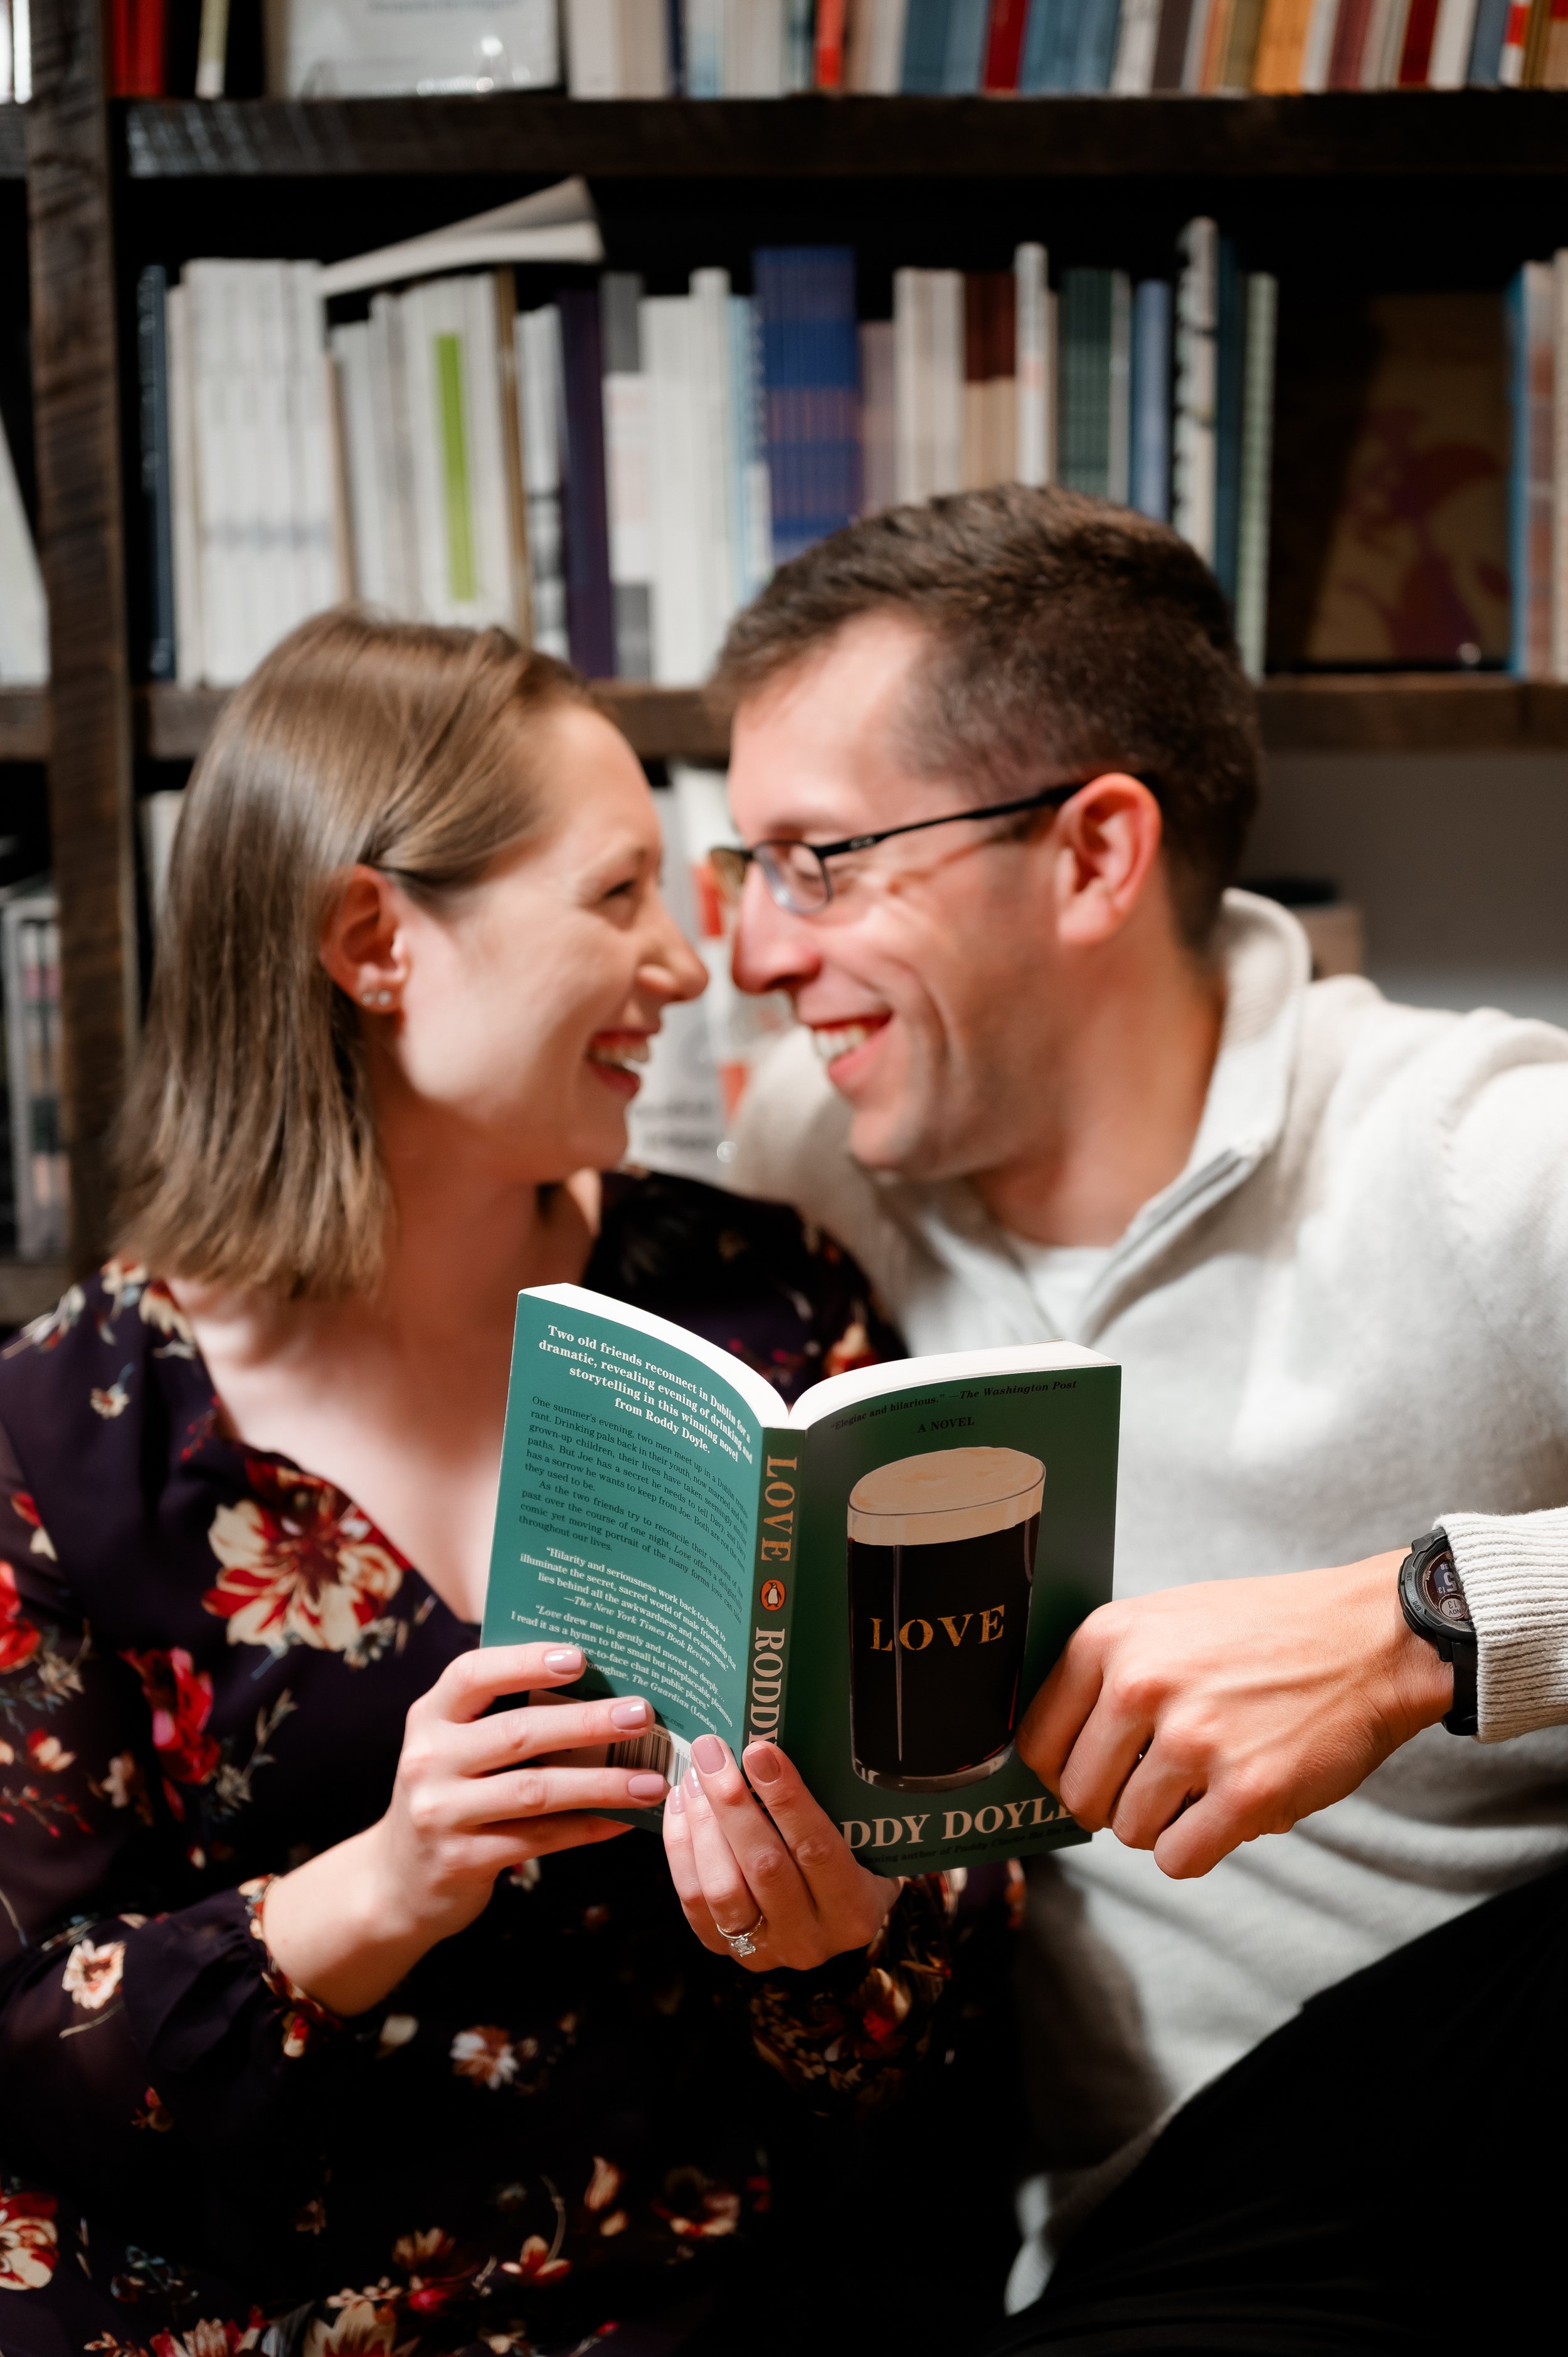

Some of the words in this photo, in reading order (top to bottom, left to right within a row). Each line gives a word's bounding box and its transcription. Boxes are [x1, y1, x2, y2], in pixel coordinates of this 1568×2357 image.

[539, 1339, 597, 1368] dramatic,
[601, 1361, 655, 1390] revealing
[658, 1385, 697, 1413] evening
[699, 1407, 710, 1419] of
[711, 1413, 742, 1451] drinking
[742, 1446, 752, 1464] and
[548, 1325, 574, 1342] Two
[578, 1336, 596, 1349] old
[600, 1343, 642, 1366] friends
[645, 1361, 697, 1394] reconnect
[699, 1387, 707, 1402] in
[710, 1394, 735, 1425] Dublin
[737, 1419, 747, 1439] for
[569, 1368, 641, 1401] storytelling
[643, 1391, 654, 1405] in
[658, 1400, 678, 1417] this
[681, 1412, 718, 1444] winning
[719, 1439, 738, 1462] novel
[869, 1405, 887, 1418] and
[983, 1383, 1049, 1397] Washington
[1052, 1380, 1078, 1390] Post
[531, 1411, 551, 1422] rant.
[554, 1416, 595, 1438] Drinking
[596, 1432, 615, 1443] pals
[617, 1437, 637, 1452] back
[639, 1446, 647, 1456] in
[649, 1451, 668, 1466] their
[669, 1462, 691, 1481] youth,
[693, 1476, 707, 1489] now
[708, 1486, 730, 1510] married
[532, 1396, 550, 1408] One
[599, 1419, 634, 1439] evening,
[637, 1433, 653, 1445] two
[655, 1441, 672, 1454] men
[674, 1451, 692, 1466] meet
[694, 1462, 702, 1473] up
[718, 1477, 734, 1501] Dublin
[615, 1397, 642, 1417] from
[645, 1408, 679, 1435] Roddy
[681, 1427, 710, 1454] Doyle.
[918, 1423, 927, 1433] A
[931, 1415, 975, 1431] NOVEL
[525, 1463, 544, 1476] they
[548, 1470, 568, 1482] used
[526, 1449, 543, 1460] has
[551, 1459, 584, 1473] sorrow
[599, 1474, 625, 1487] wants
[637, 1486, 657, 1503] keep
[659, 1496, 677, 1512] from
[678, 1506, 692, 1521] Joe.
[694, 1515, 709, 1533] Both
[527, 1437, 554, 1451] paths.
[559, 1445, 575, 1457] But
[578, 1451, 593, 1463] Joe
[596, 1457, 612, 1470] has
[623, 1469, 649, 1484] secret
[664, 1486, 686, 1503] needs
[710, 1513, 725, 1535] Davy,
[529, 1424, 572, 1444] grown-up
[576, 1438, 615, 1458] children,
[618, 1452, 639, 1466] their
[642, 1460, 660, 1476] lives
[663, 1471, 681, 1486] have
[684, 1482, 702, 1501] taken
[704, 1498, 732, 1527] seemingly
[760, 1455, 798, 1562] LOVE
[519, 1516, 569, 1537] throughout
[572, 1533, 588, 1542] our
[590, 1536, 612, 1551] lives.
[520, 1504, 548, 1516] comic
[551, 1513, 565, 1522] yet
[569, 1518, 602, 1535] moving
[605, 1530, 638, 1548] portrait
[669, 1556, 689, 1573] many
[691, 1569, 709, 1588] forms
[522, 1491, 541, 1501] past
[544, 1498, 565, 1508] over
[568, 1503, 583, 1514] the
[586, 1510, 615, 1525] course
[630, 1526, 645, 1537] one
[649, 1534, 670, 1550] night,
[674, 1545, 691, 1561] Love
[693, 1558, 711, 1576] offers
[555, 1486, 569, 1496] the
[573, 1491, 590, 1503] two
[593, 1497, 624, 1514] friends
[655, 1523, 689, 1546] reconcile
[692, 1543, 707, 1558] their
[709, 1556, 731, 1581] versions
[520, 1553, 568, 1574] illuminate
[569, 1568, 585, 1579] the
[586, 1575, 617, 1591] secret,
[618, 1586, 648, 1602] sacred
[649, 1598, 672, 1614] world
[674, 1611, 682, 1619] of
[682, 1615, 699, 1631] male
[701, 1627, 728, 1659] friendship
[538, 1572, 555, 1584] lies
[556, 1577, 589, 1594] behind
[590, 1589, 603, 1599] all
[605, 1593, 619, 1604] the
[621, 1600, 677, 1630] awkwardness
[678, 1627, 692, 1640] and
[587, 1562, 605, 1572] and
[606, 1568, 657, 1593] seriousness
[659, 1589, 678, 1604] work
[679, 1598, 719, 1636] back-to-back
[593, 1602, 615, 1615] New
[617, 1610, 637, 1624] York
[639, 1619, 665, 1637] Times
[666, 1632, 686, 1648] Book
[686, 1644, 711, 1667] Review
[870, 1604, 1005, 1651] LOVE
[1448, 1600, 1456, 1609] 13
[517, 1615, 538, 1627] read
[569, 1627, 596, 1643] hymn
[610, 1641, 625, 1652] the
[627, 1647, 651, 1662] small
[652, 1656, 665, 1669] but
[667, 1663, 711, 1700] irreplaceable
[563, 1613, 588, 1625] drew
[590, 1622, 604, 1631] me
[617, 1631, 644, 1646] gently
[645, 1642, 661, 1654] and
[662, 1649, 687, 1668] moved
[630, 1662, 650, 1674] chat
[661, 1675, 684, 1693] public
[632, 1674, 649, 1687] The
[650, 1682, 690, 1709] Guardian
[691, 1705, 717, 1734] (London)
[840, 1814, 931, 1849] DDY
